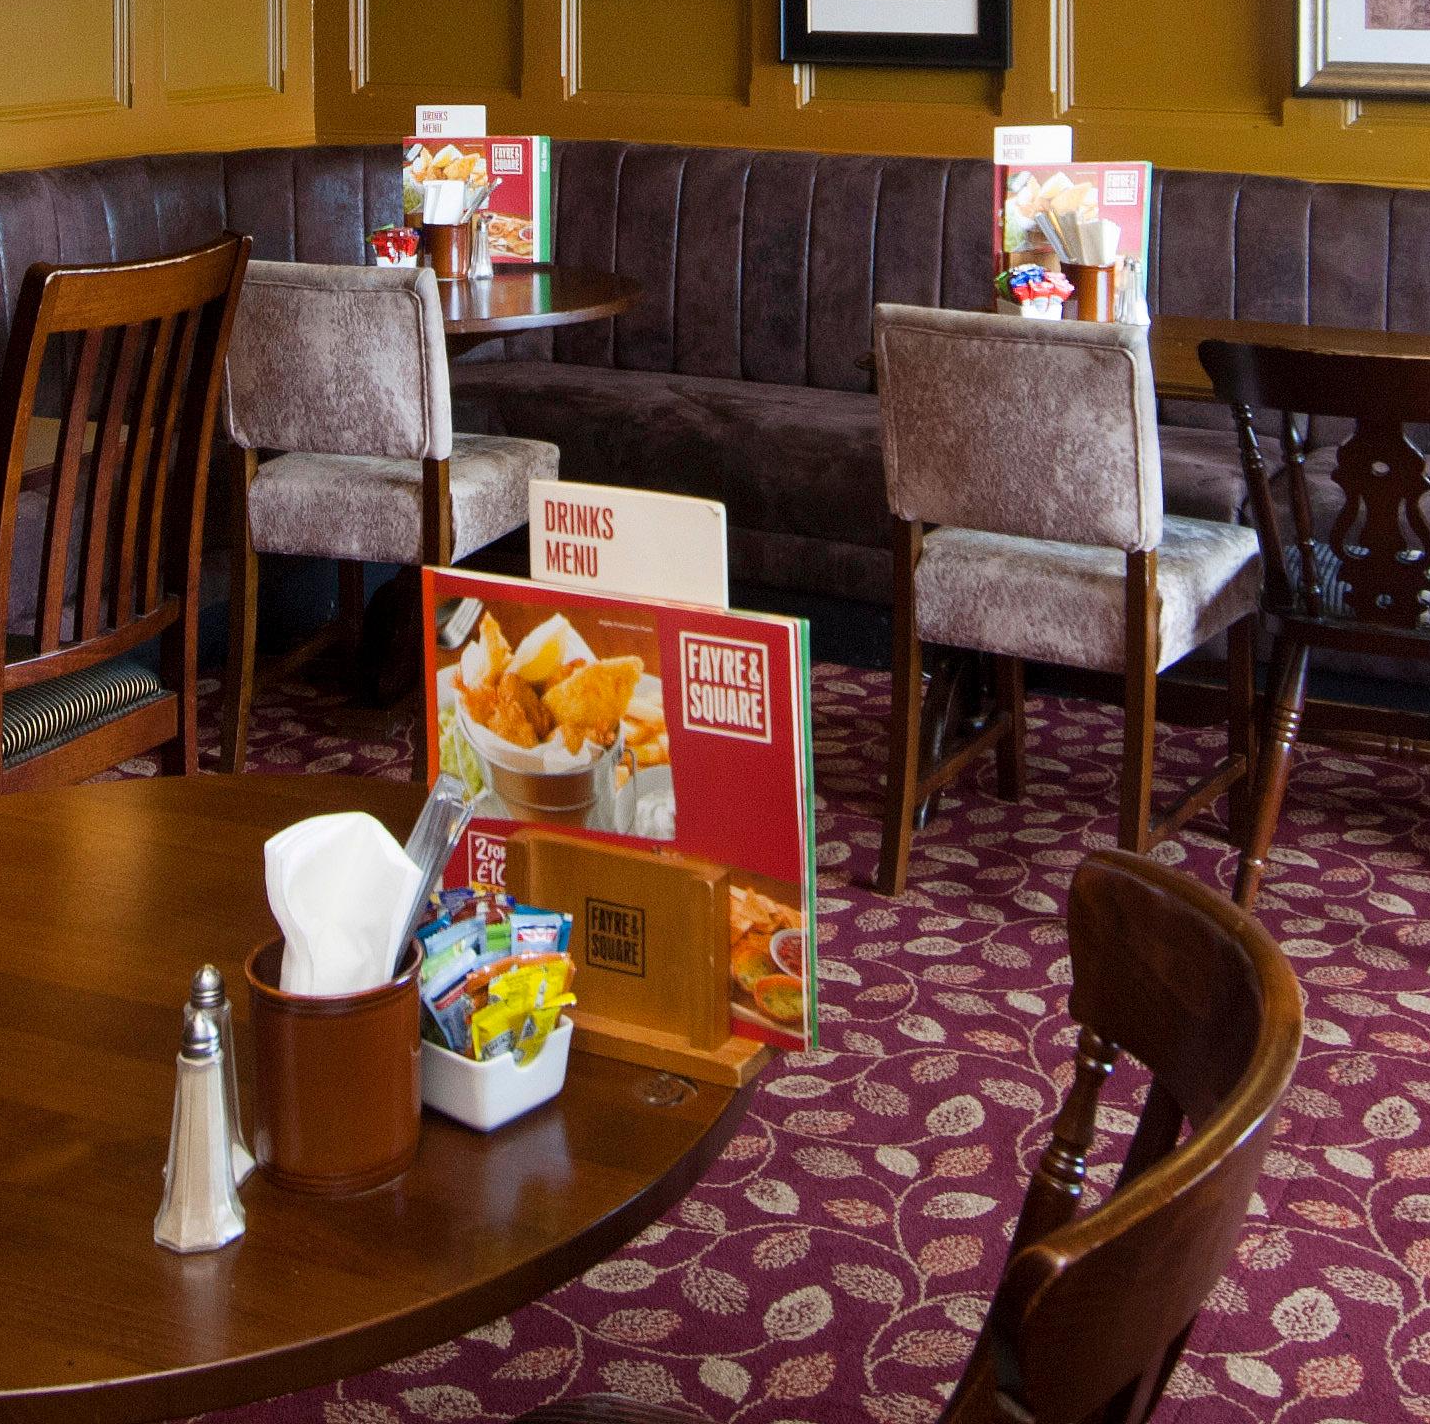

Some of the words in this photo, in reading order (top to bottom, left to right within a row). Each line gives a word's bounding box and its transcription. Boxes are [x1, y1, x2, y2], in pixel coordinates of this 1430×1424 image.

[544, 499, 614, 541] DRINKS
[546, 539, 598, 577] MENU
[688, 642, 747, 688] FAYRE
[748, 652, 762, 689] &
[689, 682, 763, 730] SQUARE
[591, 907, 629, 936] FAYRE
[592, 934, 639, 966] SQUARE
